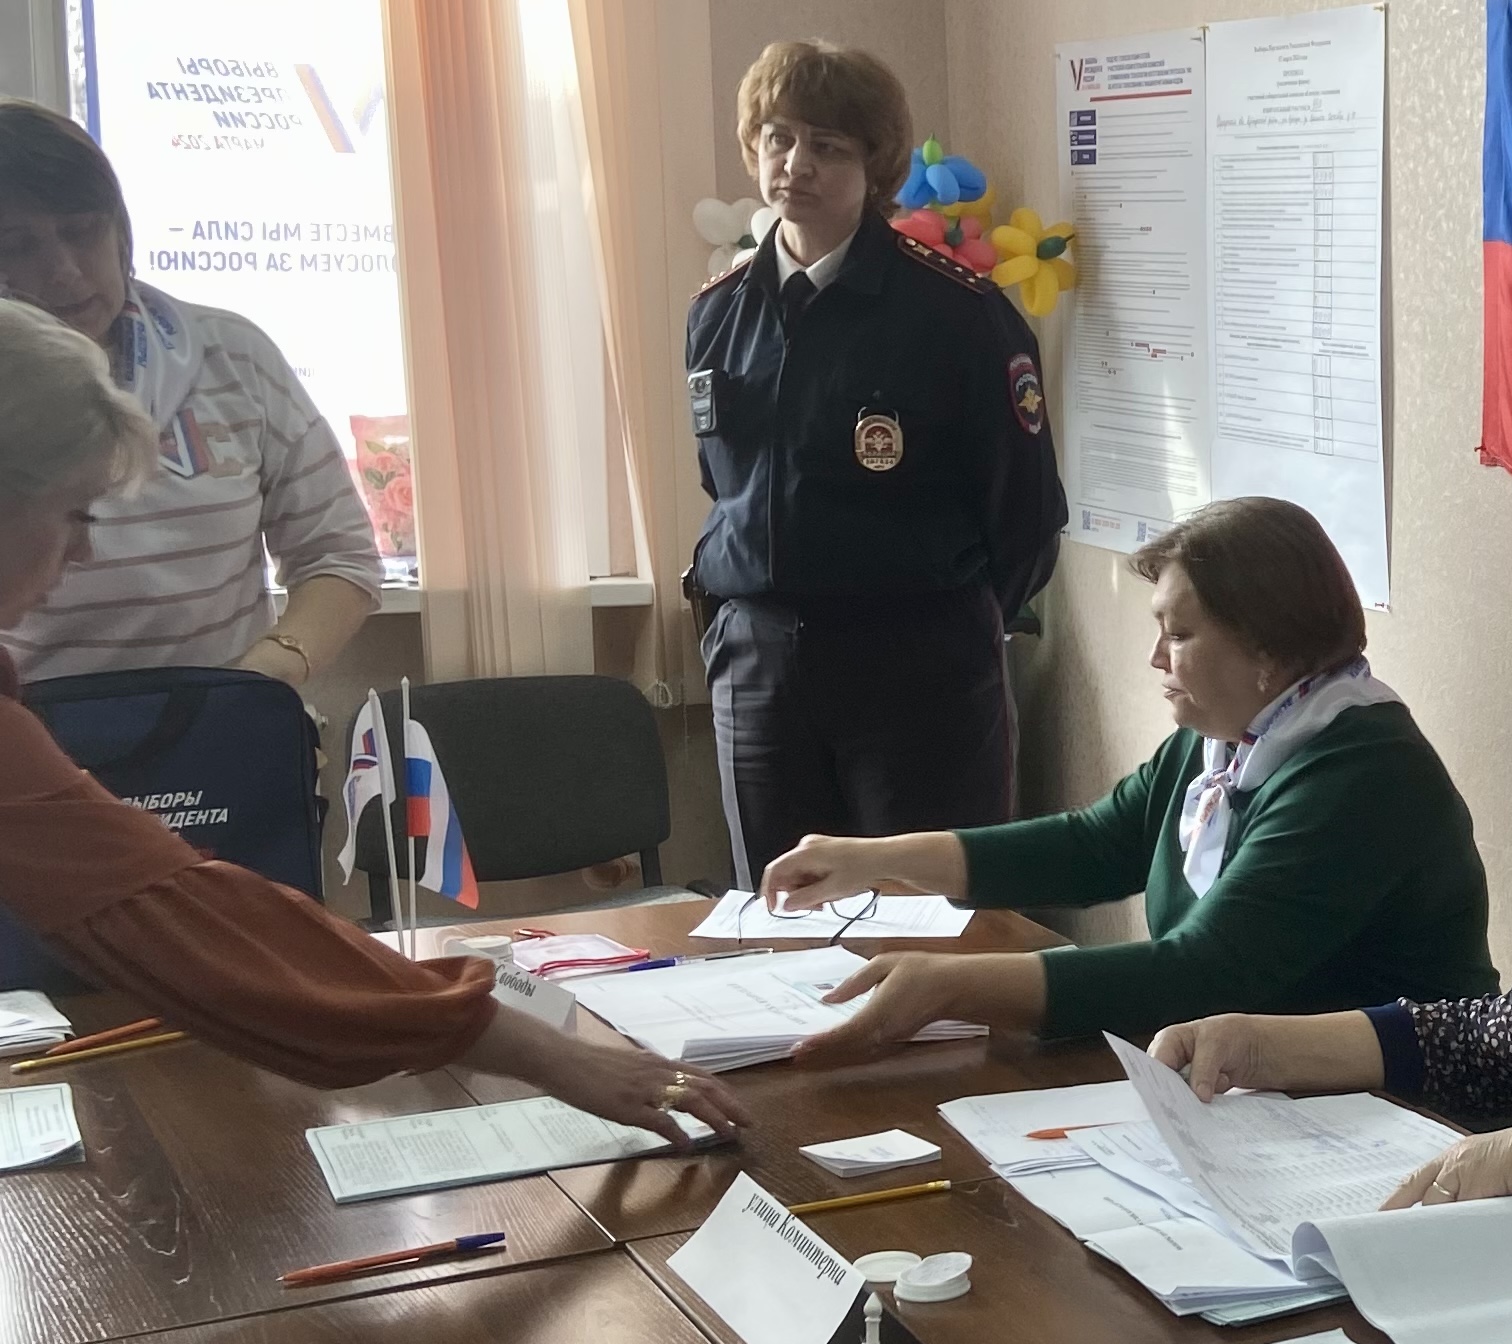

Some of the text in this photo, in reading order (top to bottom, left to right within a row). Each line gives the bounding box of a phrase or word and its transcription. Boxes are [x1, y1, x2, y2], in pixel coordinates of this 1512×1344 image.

[495, 962, 537, 997] Свободы
[742, 1193, 848, 1286] улица Коминтерна
